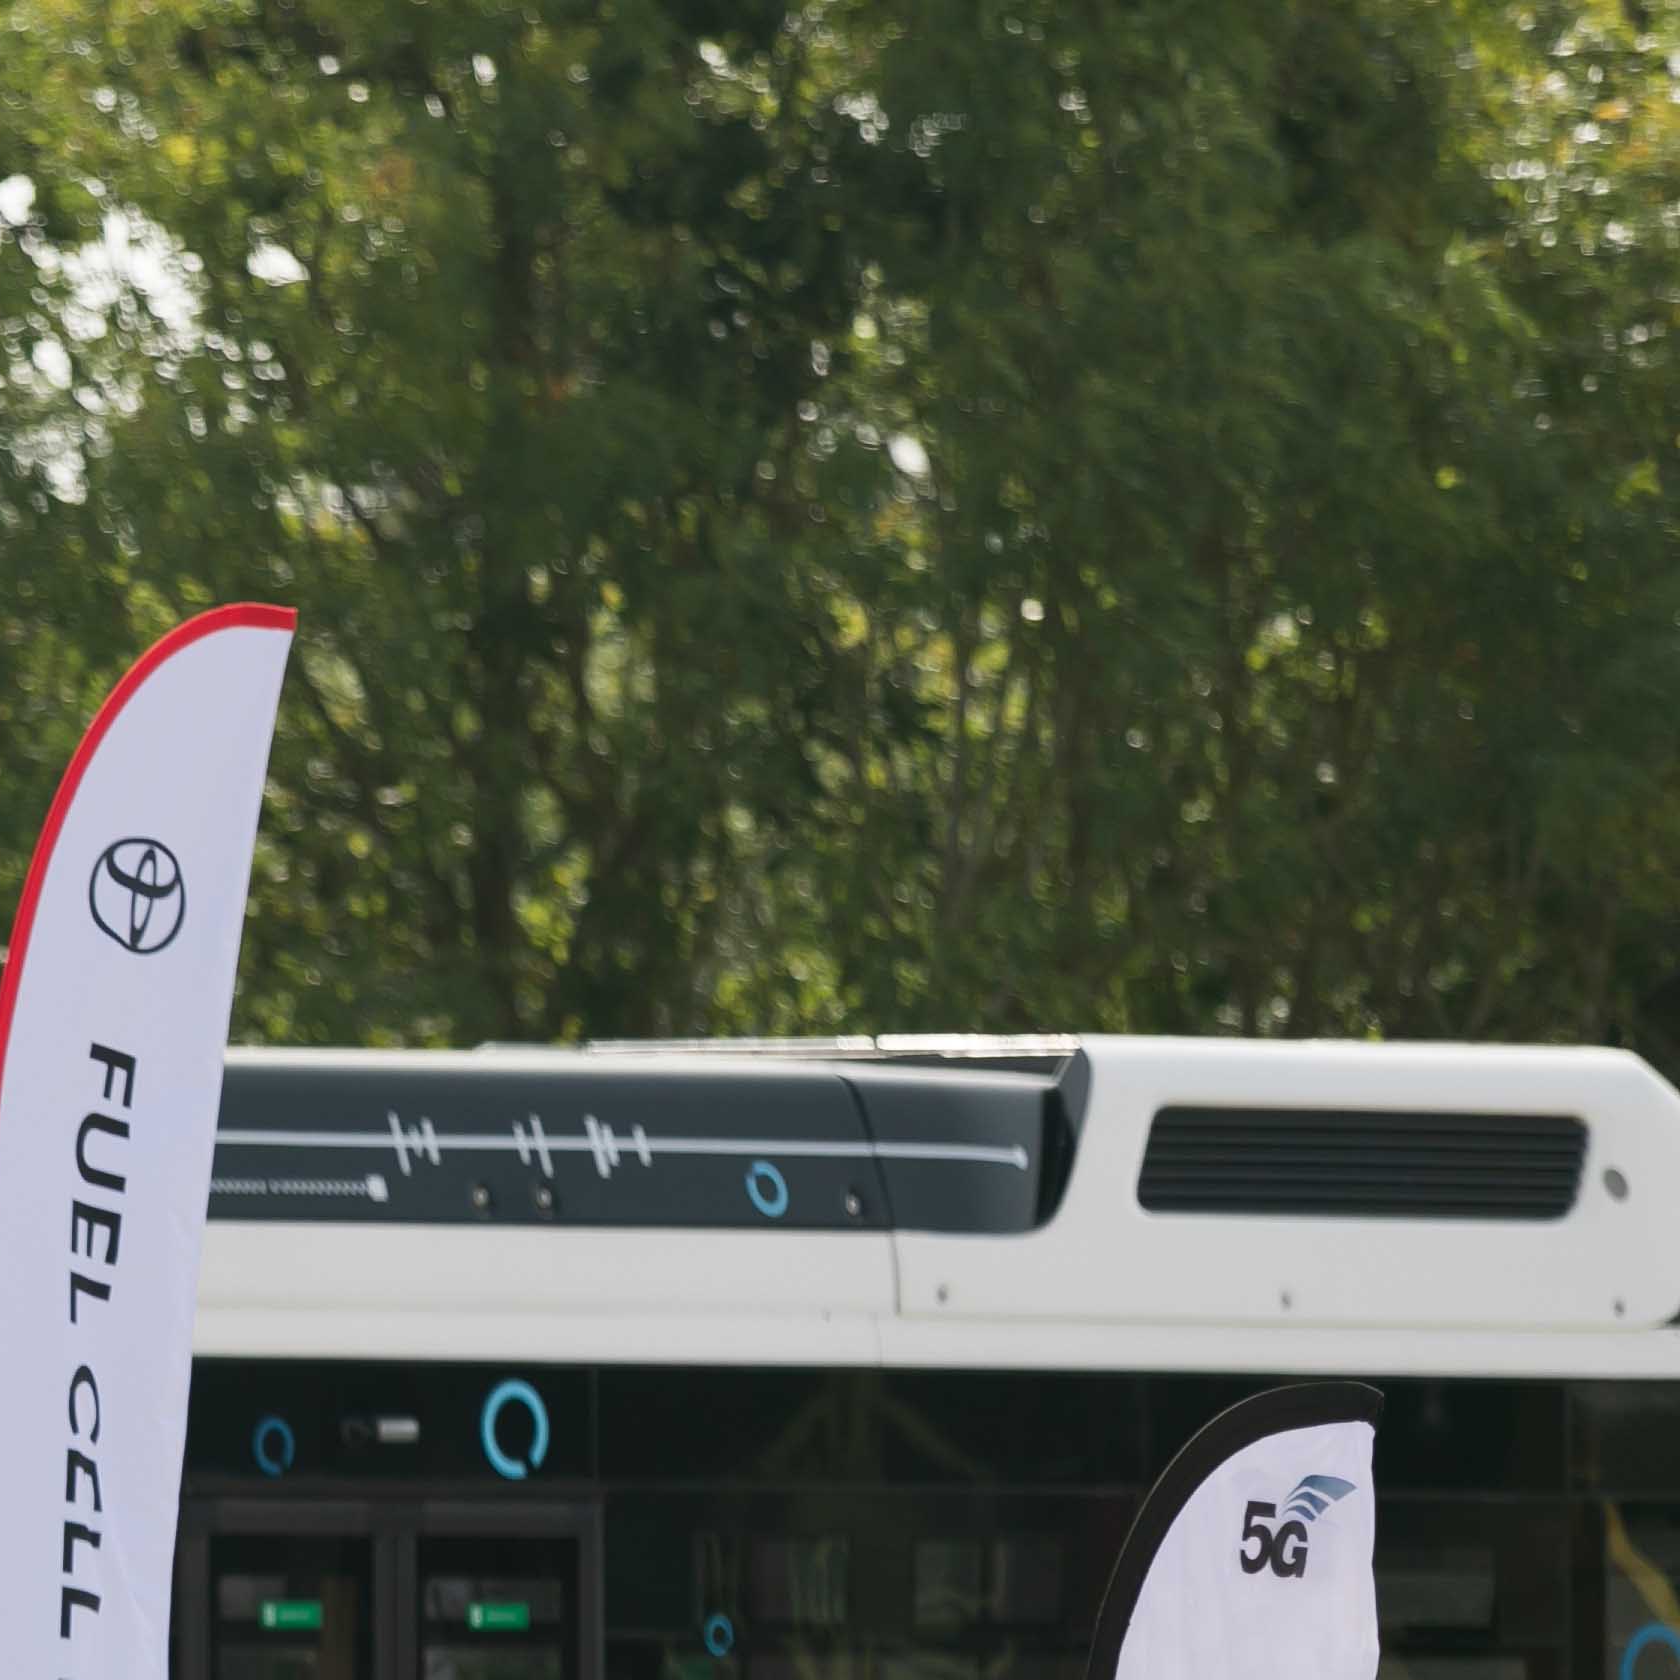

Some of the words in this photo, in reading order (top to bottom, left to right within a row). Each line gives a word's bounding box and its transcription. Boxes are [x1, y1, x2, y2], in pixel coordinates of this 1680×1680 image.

[68, 1041, 137, 1325] FUEL
[57, 1363, 103, 1640] CELL
[1239, 1499, 1311, 1580] 5G
